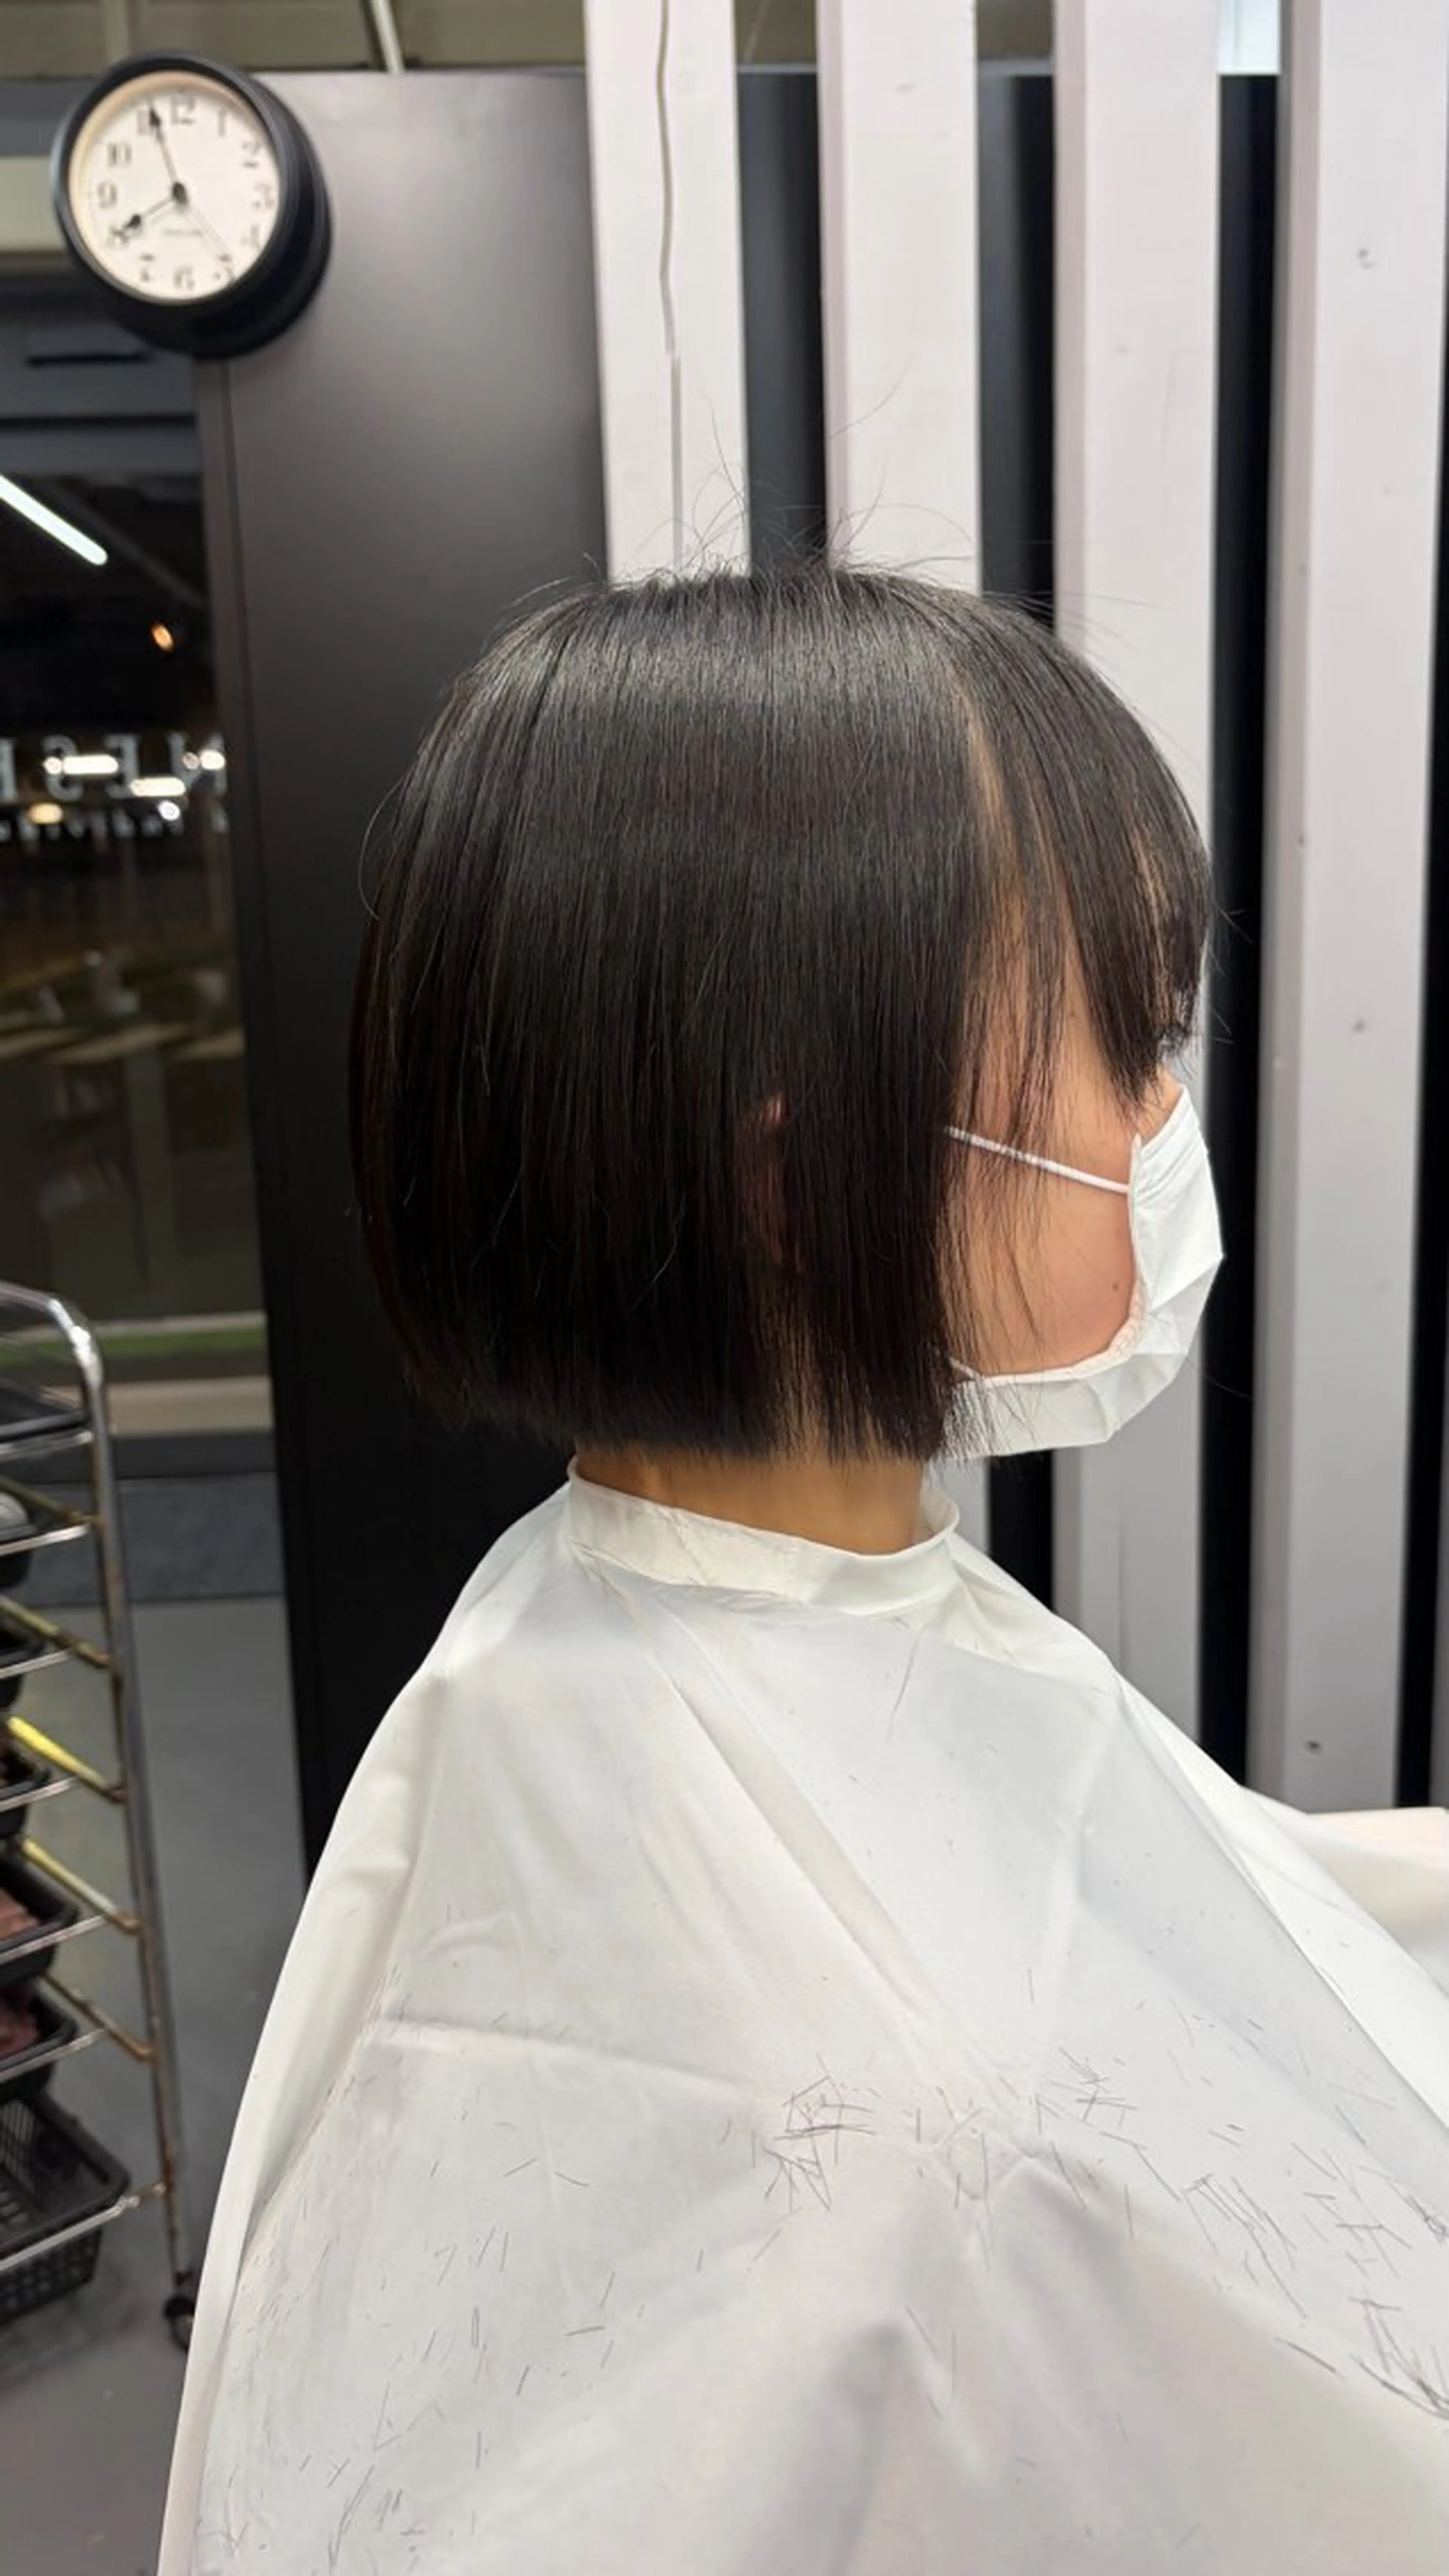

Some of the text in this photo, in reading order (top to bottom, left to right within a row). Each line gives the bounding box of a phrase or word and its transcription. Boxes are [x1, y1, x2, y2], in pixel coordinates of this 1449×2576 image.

[170, 94, 196, 125] 12
[240, 139, 262, 168] 2
[97, 181, 118, 209] 9
[252, 181, 275, 209] 3
[173, 266, 196, 291] 6
